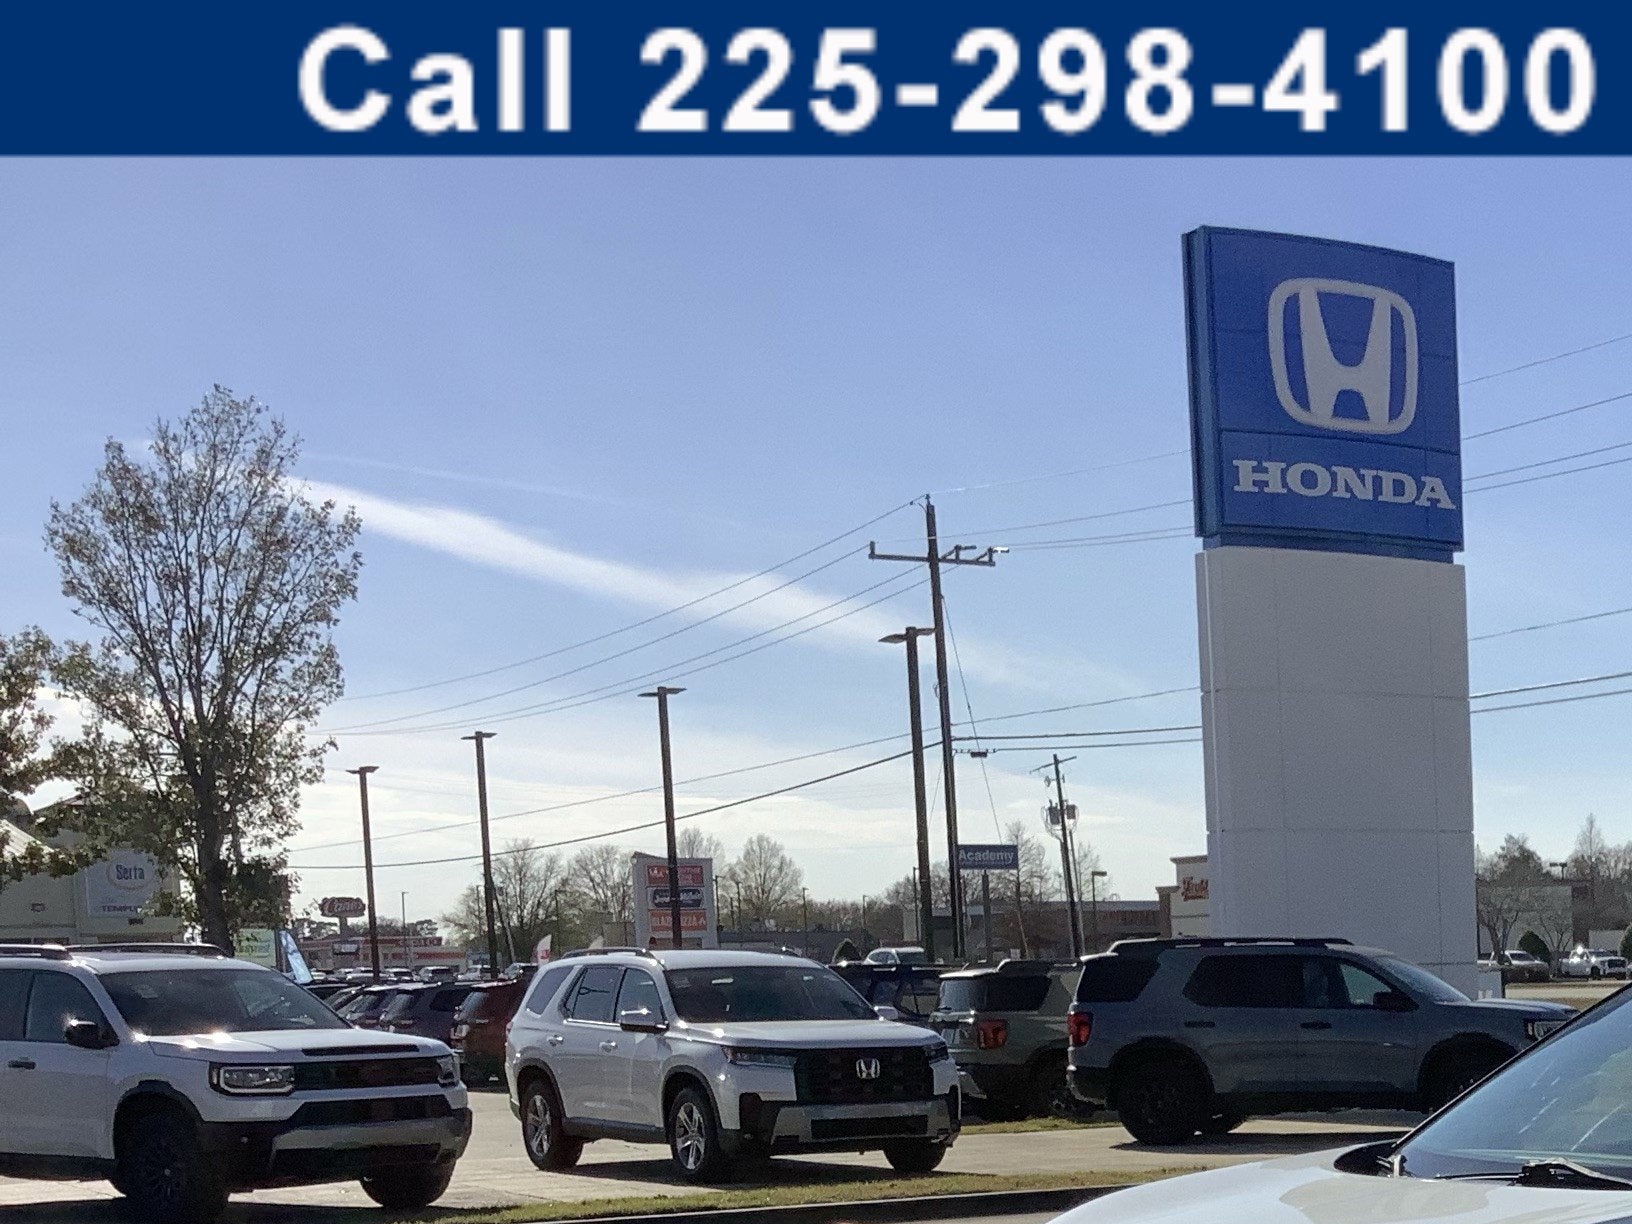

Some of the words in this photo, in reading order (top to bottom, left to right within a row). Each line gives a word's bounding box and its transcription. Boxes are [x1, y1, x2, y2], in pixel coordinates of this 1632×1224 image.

[1232, 459, 1456, 509] HONDA
[959, 849, 1015, 864] Academy
[115, 864, 145, 880] Serta
